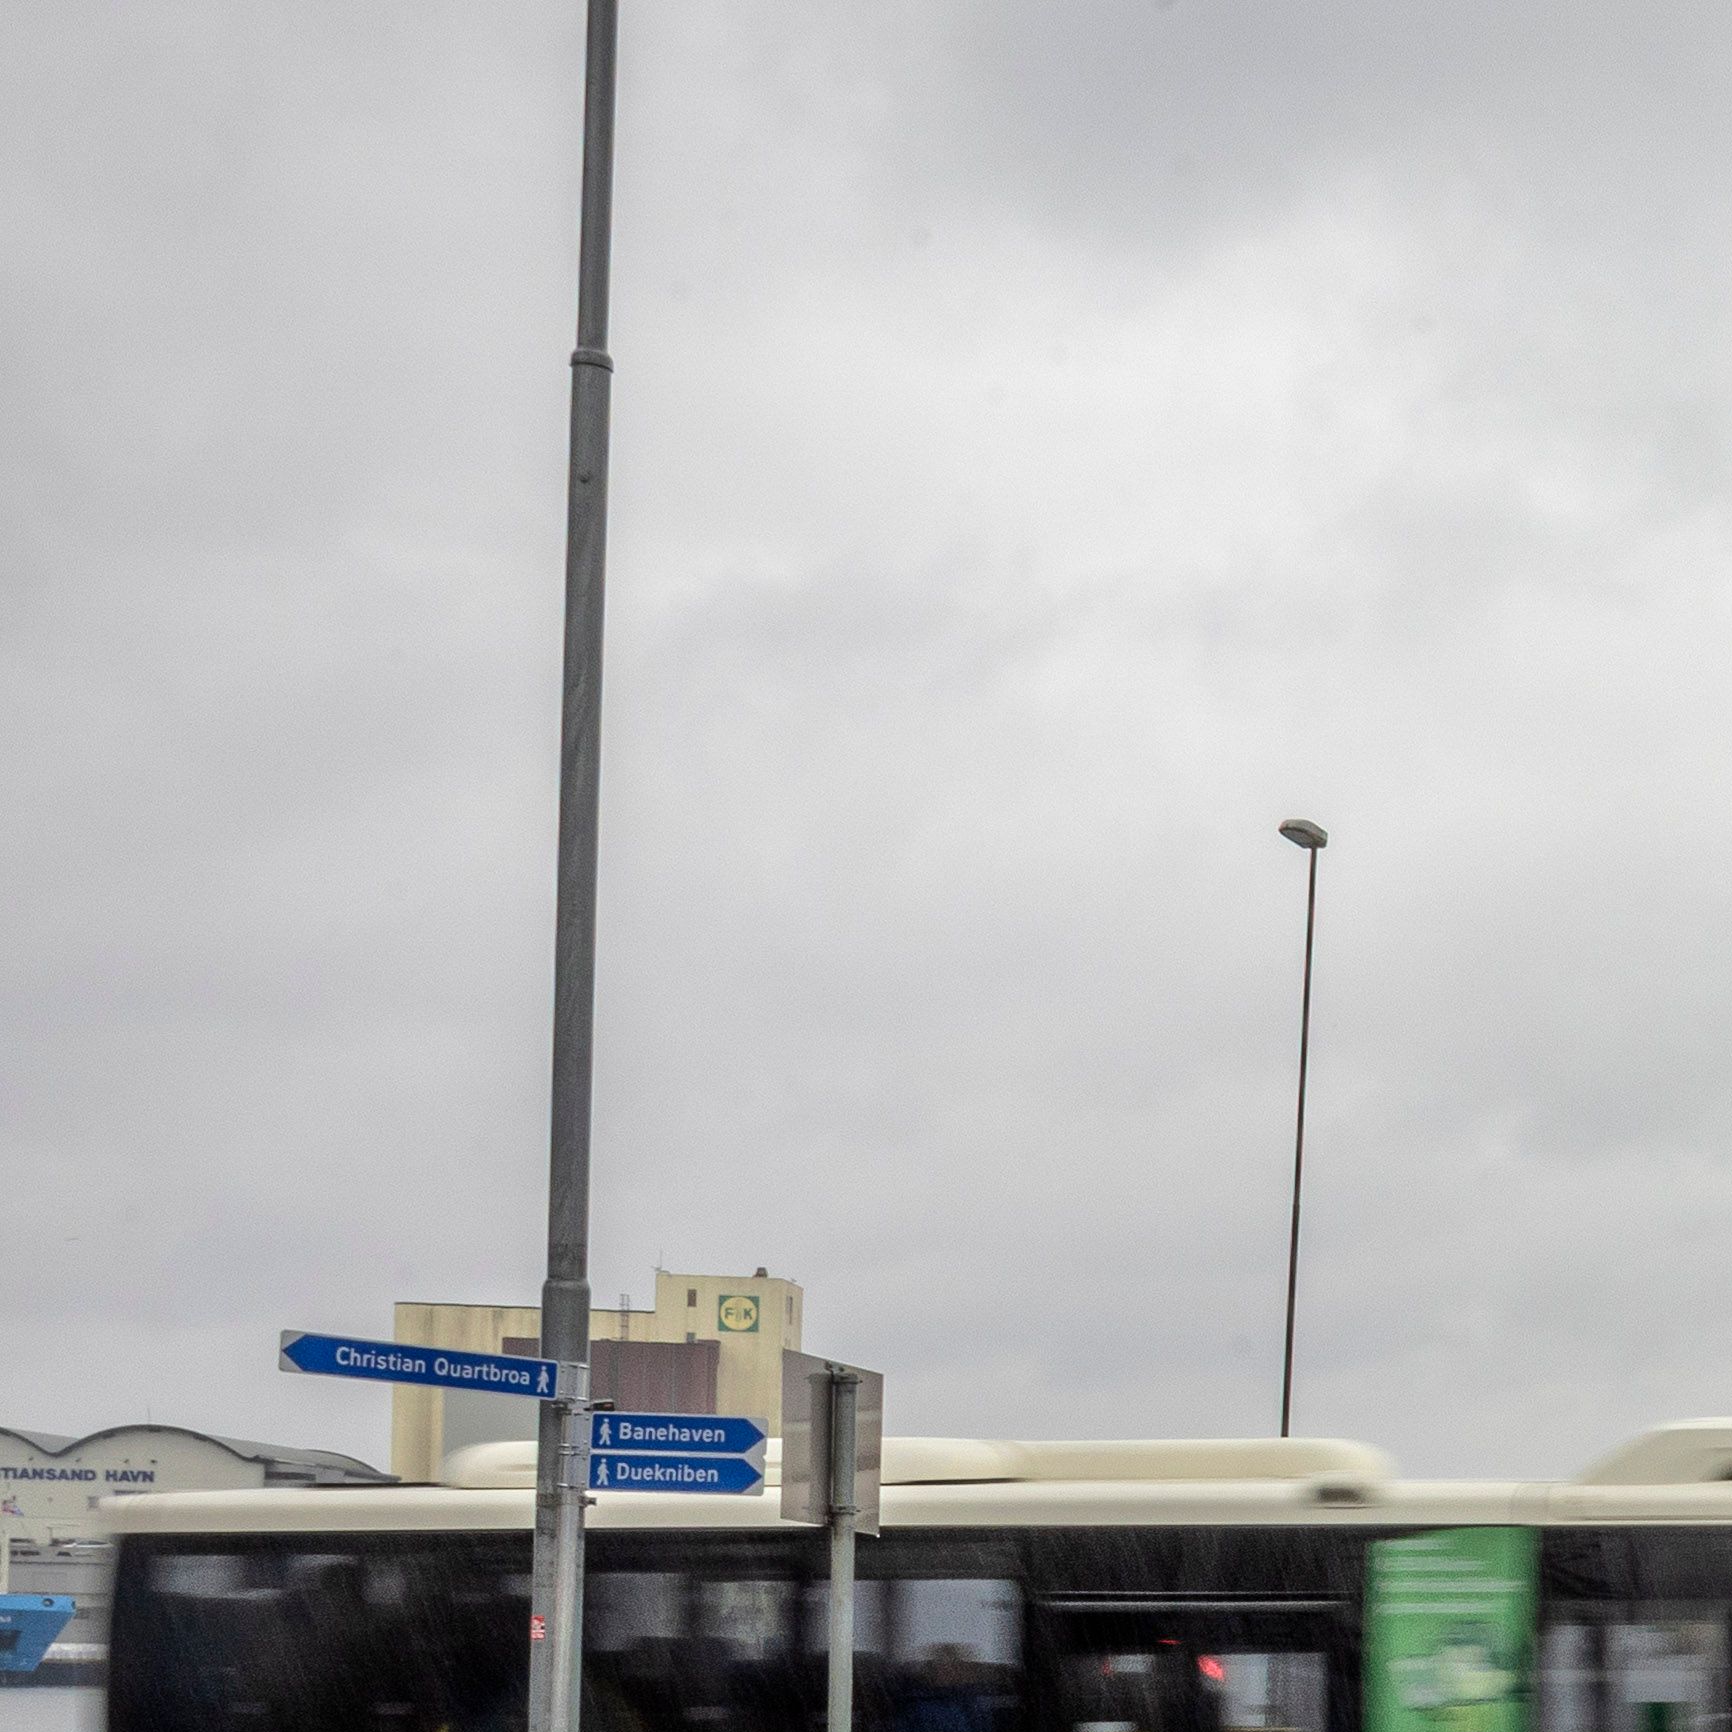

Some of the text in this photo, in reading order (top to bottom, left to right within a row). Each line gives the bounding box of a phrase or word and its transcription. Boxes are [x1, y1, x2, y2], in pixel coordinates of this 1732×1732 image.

[335, 1346, 531, 1385] Christian Quartbroa
[619, 1422, 726, 1443] Banehaven
[105, 1469, 155, 1483] HAVN
[616, 1463, 719, 1483] Duekniben
